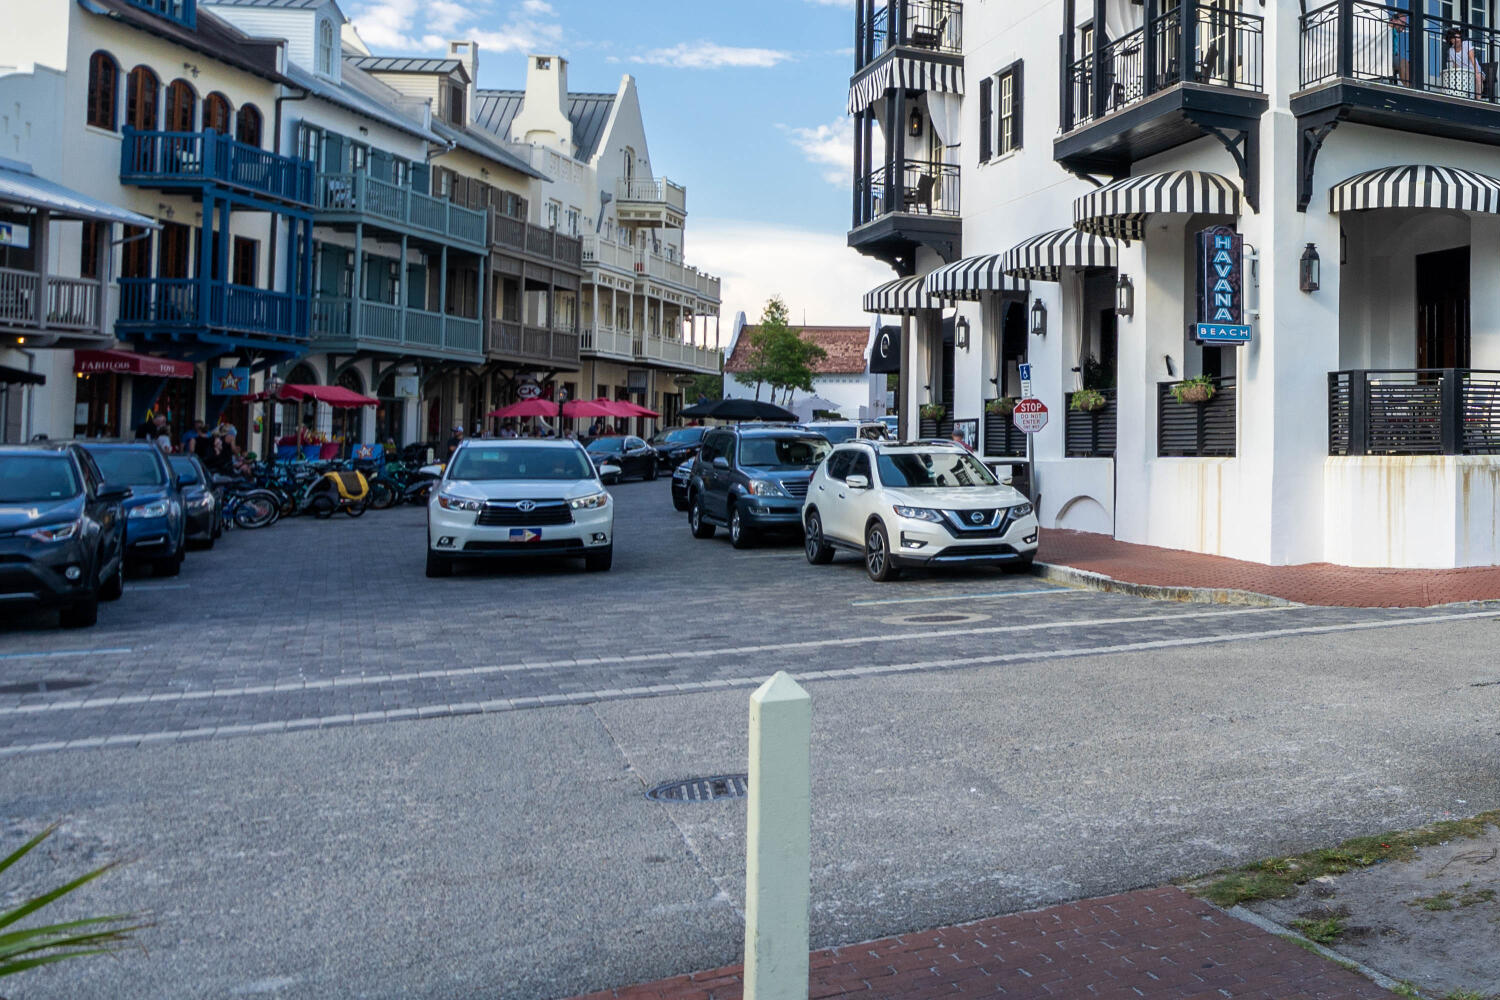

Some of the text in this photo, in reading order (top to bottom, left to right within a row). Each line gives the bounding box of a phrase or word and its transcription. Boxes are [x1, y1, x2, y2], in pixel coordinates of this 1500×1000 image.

[1213, 235, 1233, 320] HAVANA
[1200, 327, 1248, 337] BEACH
[1020, 402, 1042, 412] STOP
